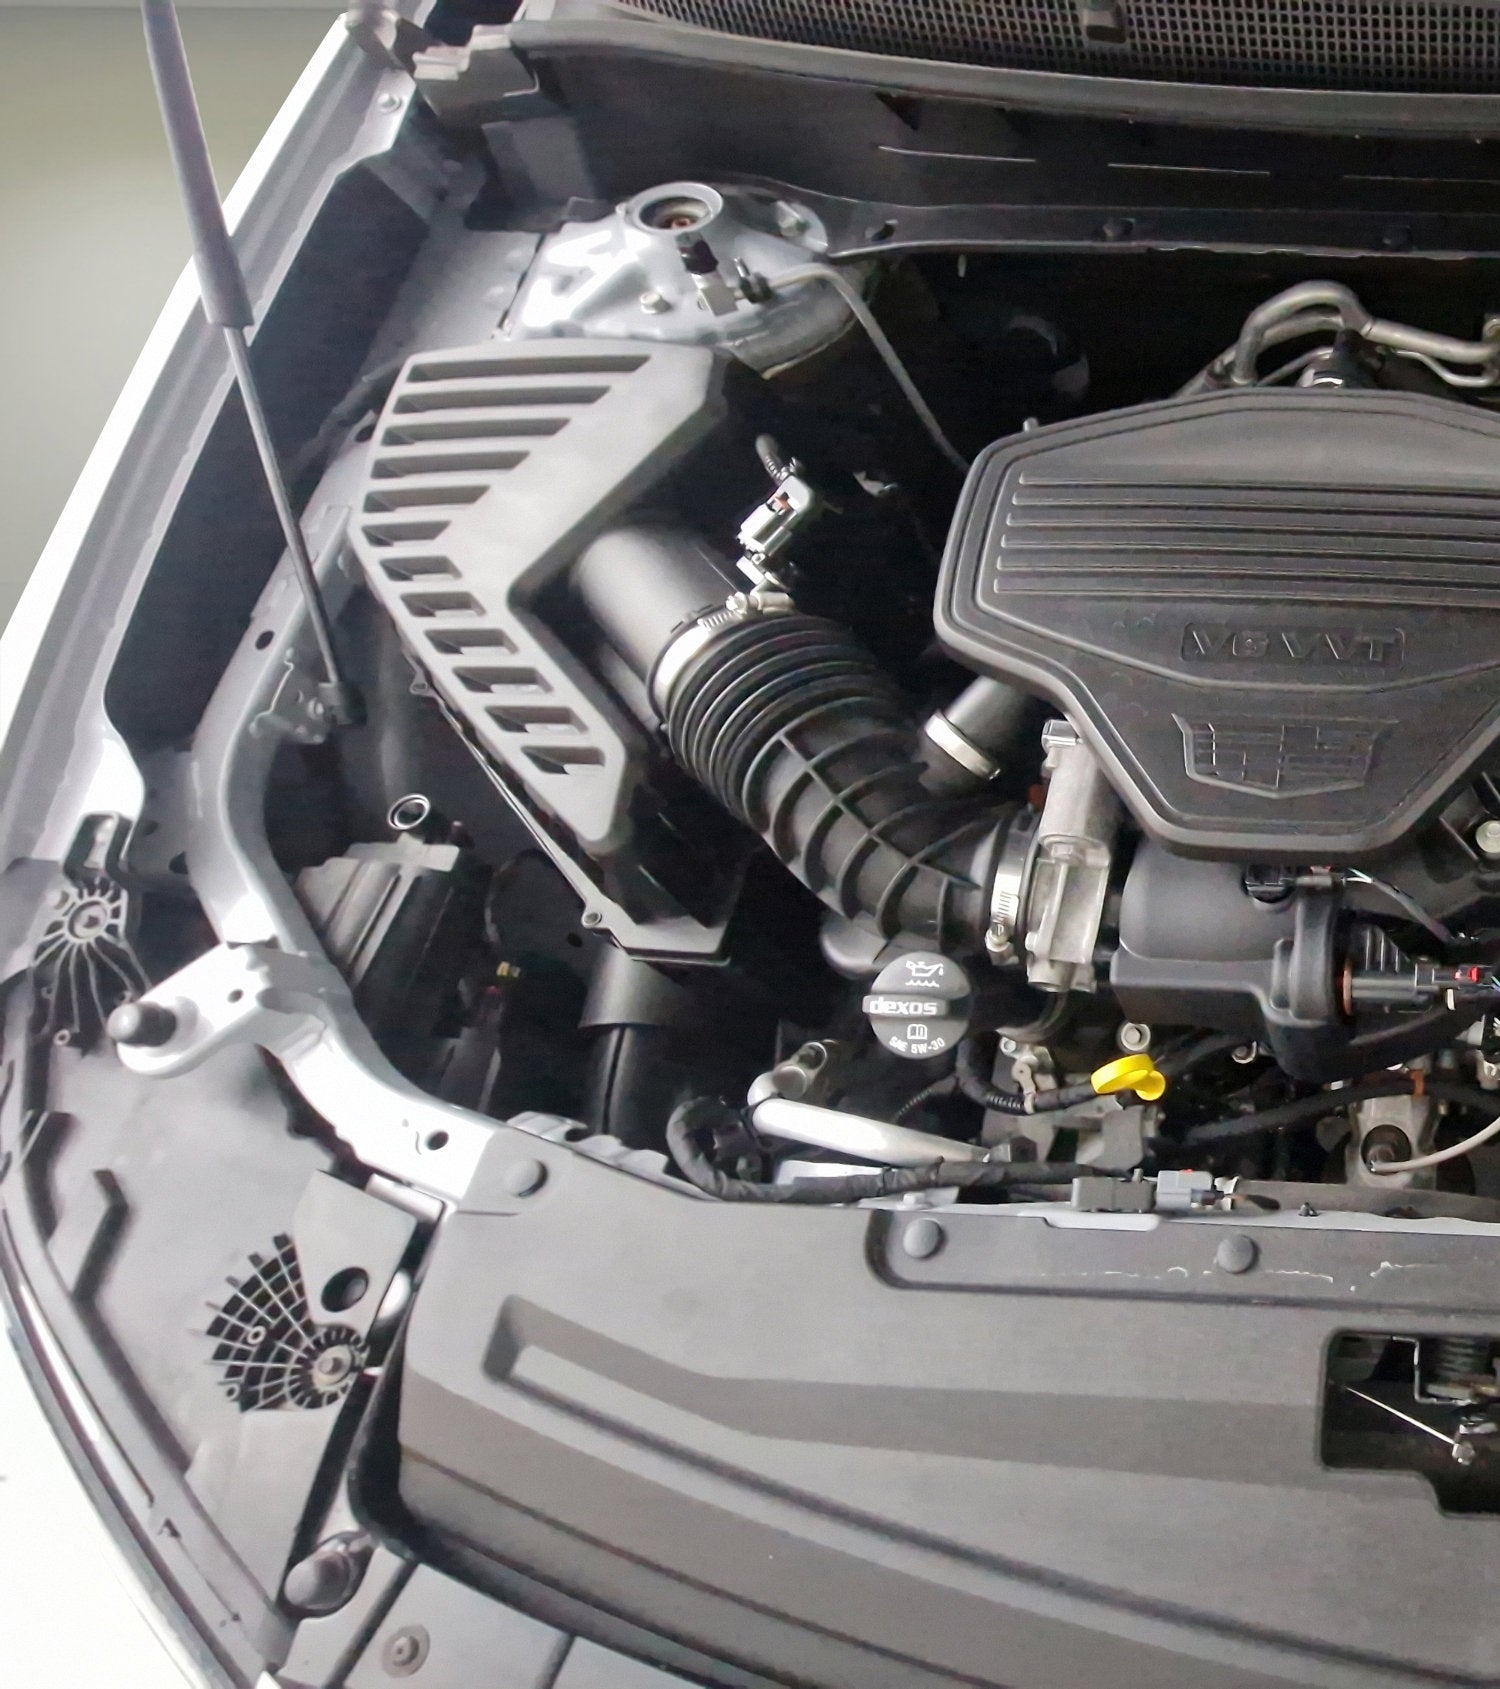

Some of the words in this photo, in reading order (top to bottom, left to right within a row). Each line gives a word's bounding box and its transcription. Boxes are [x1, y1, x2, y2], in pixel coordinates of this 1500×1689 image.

[869, 996, 938, 1016] dexos
[889, 1035, 909, 1052] SAE
[911, 1037, 946, 1054] 5W-30
